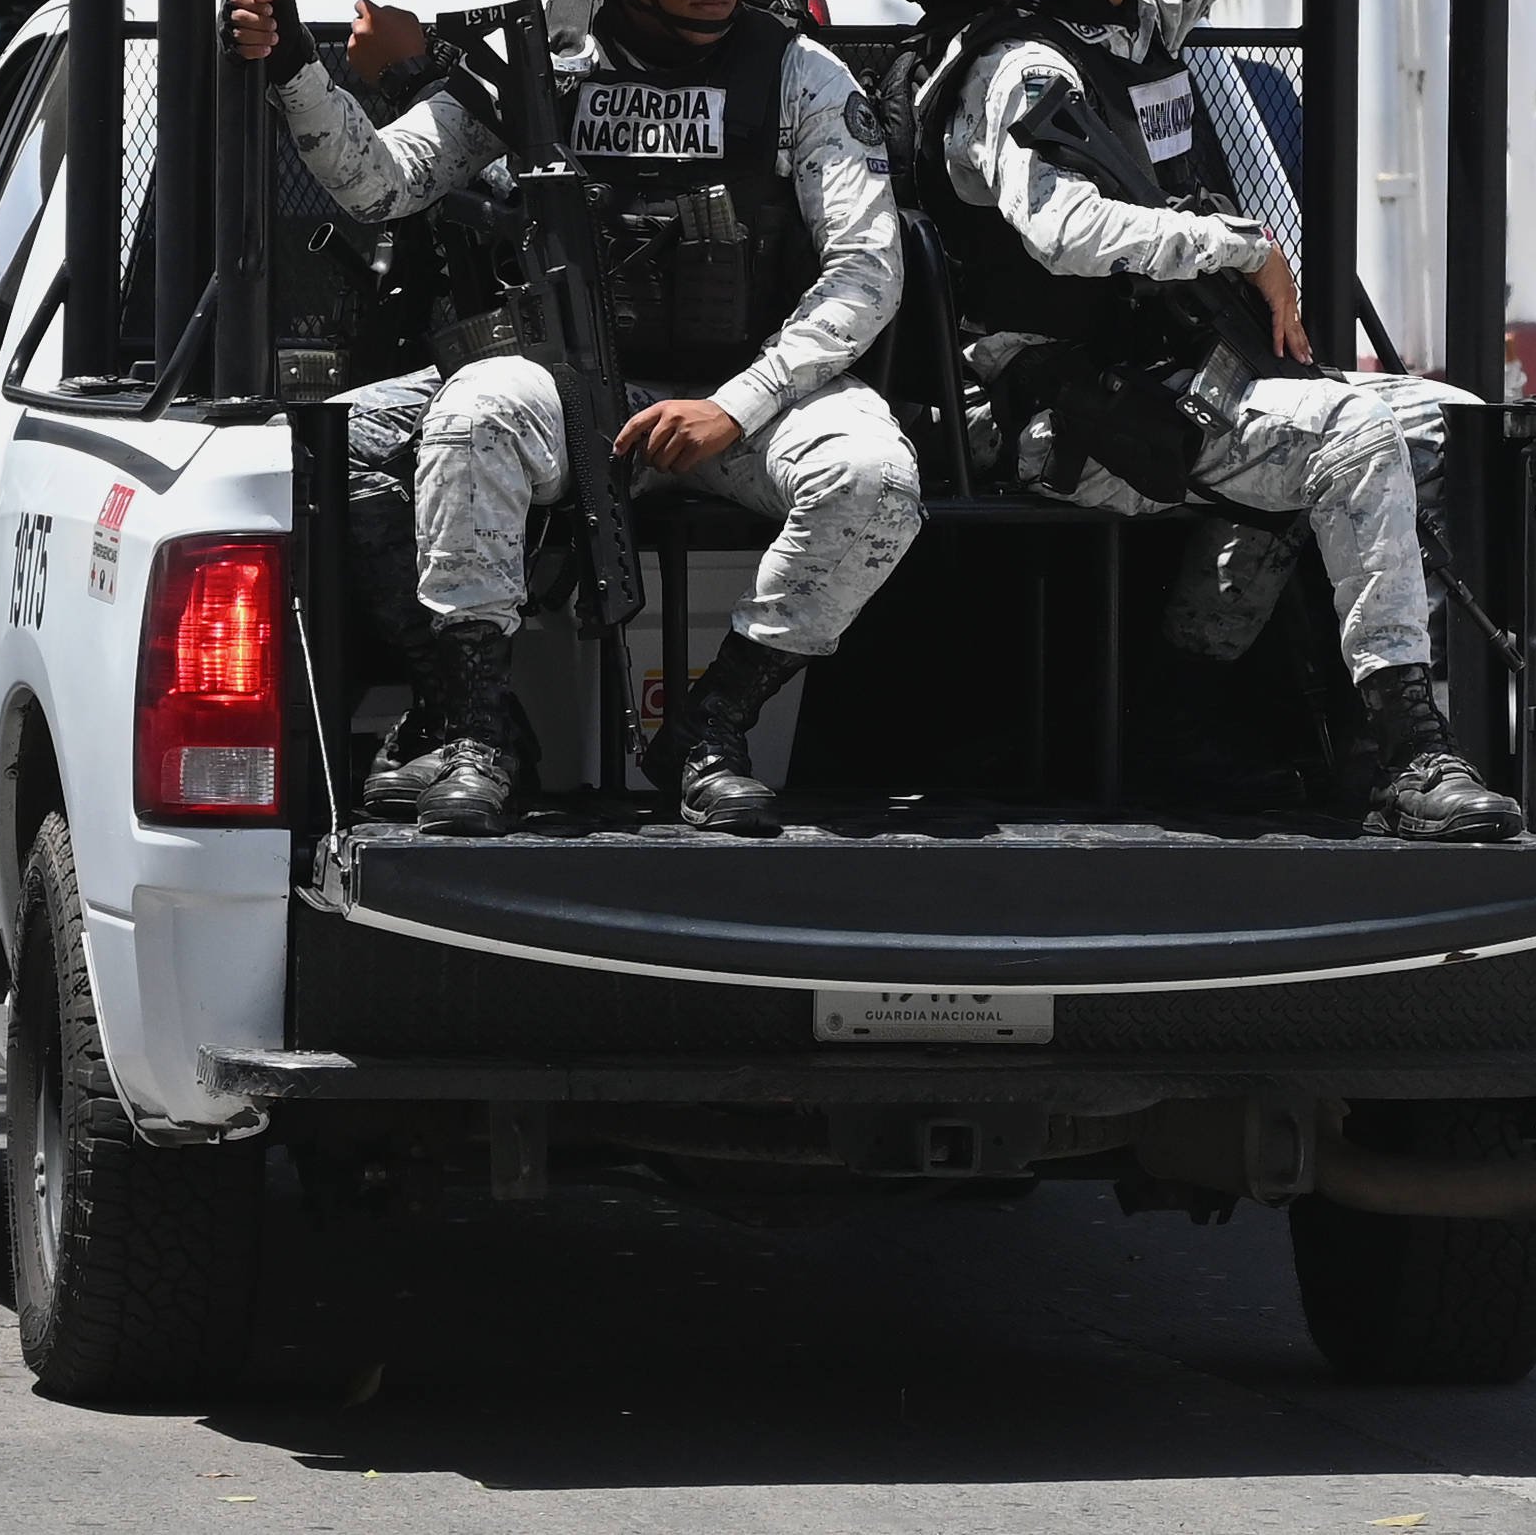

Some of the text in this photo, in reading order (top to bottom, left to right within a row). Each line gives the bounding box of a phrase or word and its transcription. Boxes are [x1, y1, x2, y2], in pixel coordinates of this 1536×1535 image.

[589, 89, 710, 119] GUARDIA
[576, 120, 718, 153] NACIONAL
[9, 512, 53, 630] 19175
[865, 1011, 1002, 1022] GUARDIA NACIONAL
